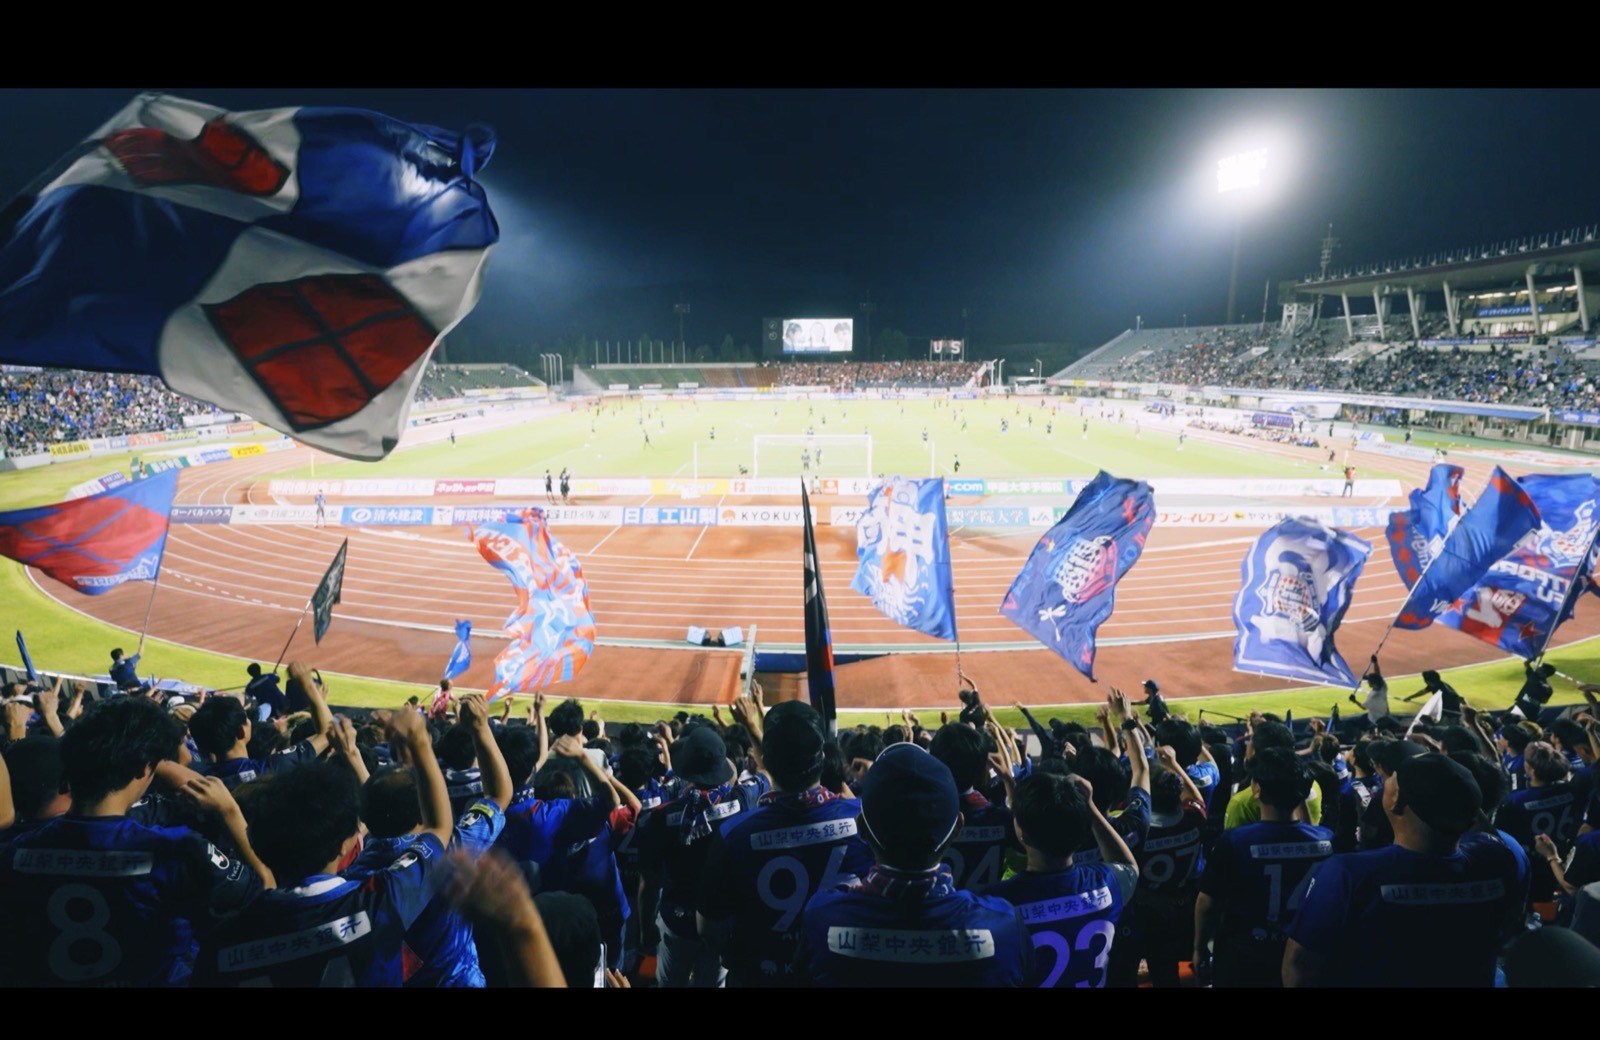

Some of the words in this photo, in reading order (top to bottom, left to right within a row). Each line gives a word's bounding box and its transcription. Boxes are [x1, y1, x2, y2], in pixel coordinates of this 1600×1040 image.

[949, 482, 983, 492] -com
[373, 508, 423, 522] 清水建設
[741, 511, 802, 521] KYOKUY
[946, 509, 1024, 524] 梨学院大学
[758, 822, 852, 846] 山梨中央銀行
[19, 852, 147, 871] 山梨中央銀行
[1020, 890, 1110, 920] 山梨中央銀行
[46, 883, 122, 981] 8
[227, 919, 363, 967] 山梨中央銀行
[837, 930, 988, 956] 山梨中央銀行
[1031, 918, 1115, 987] 23
